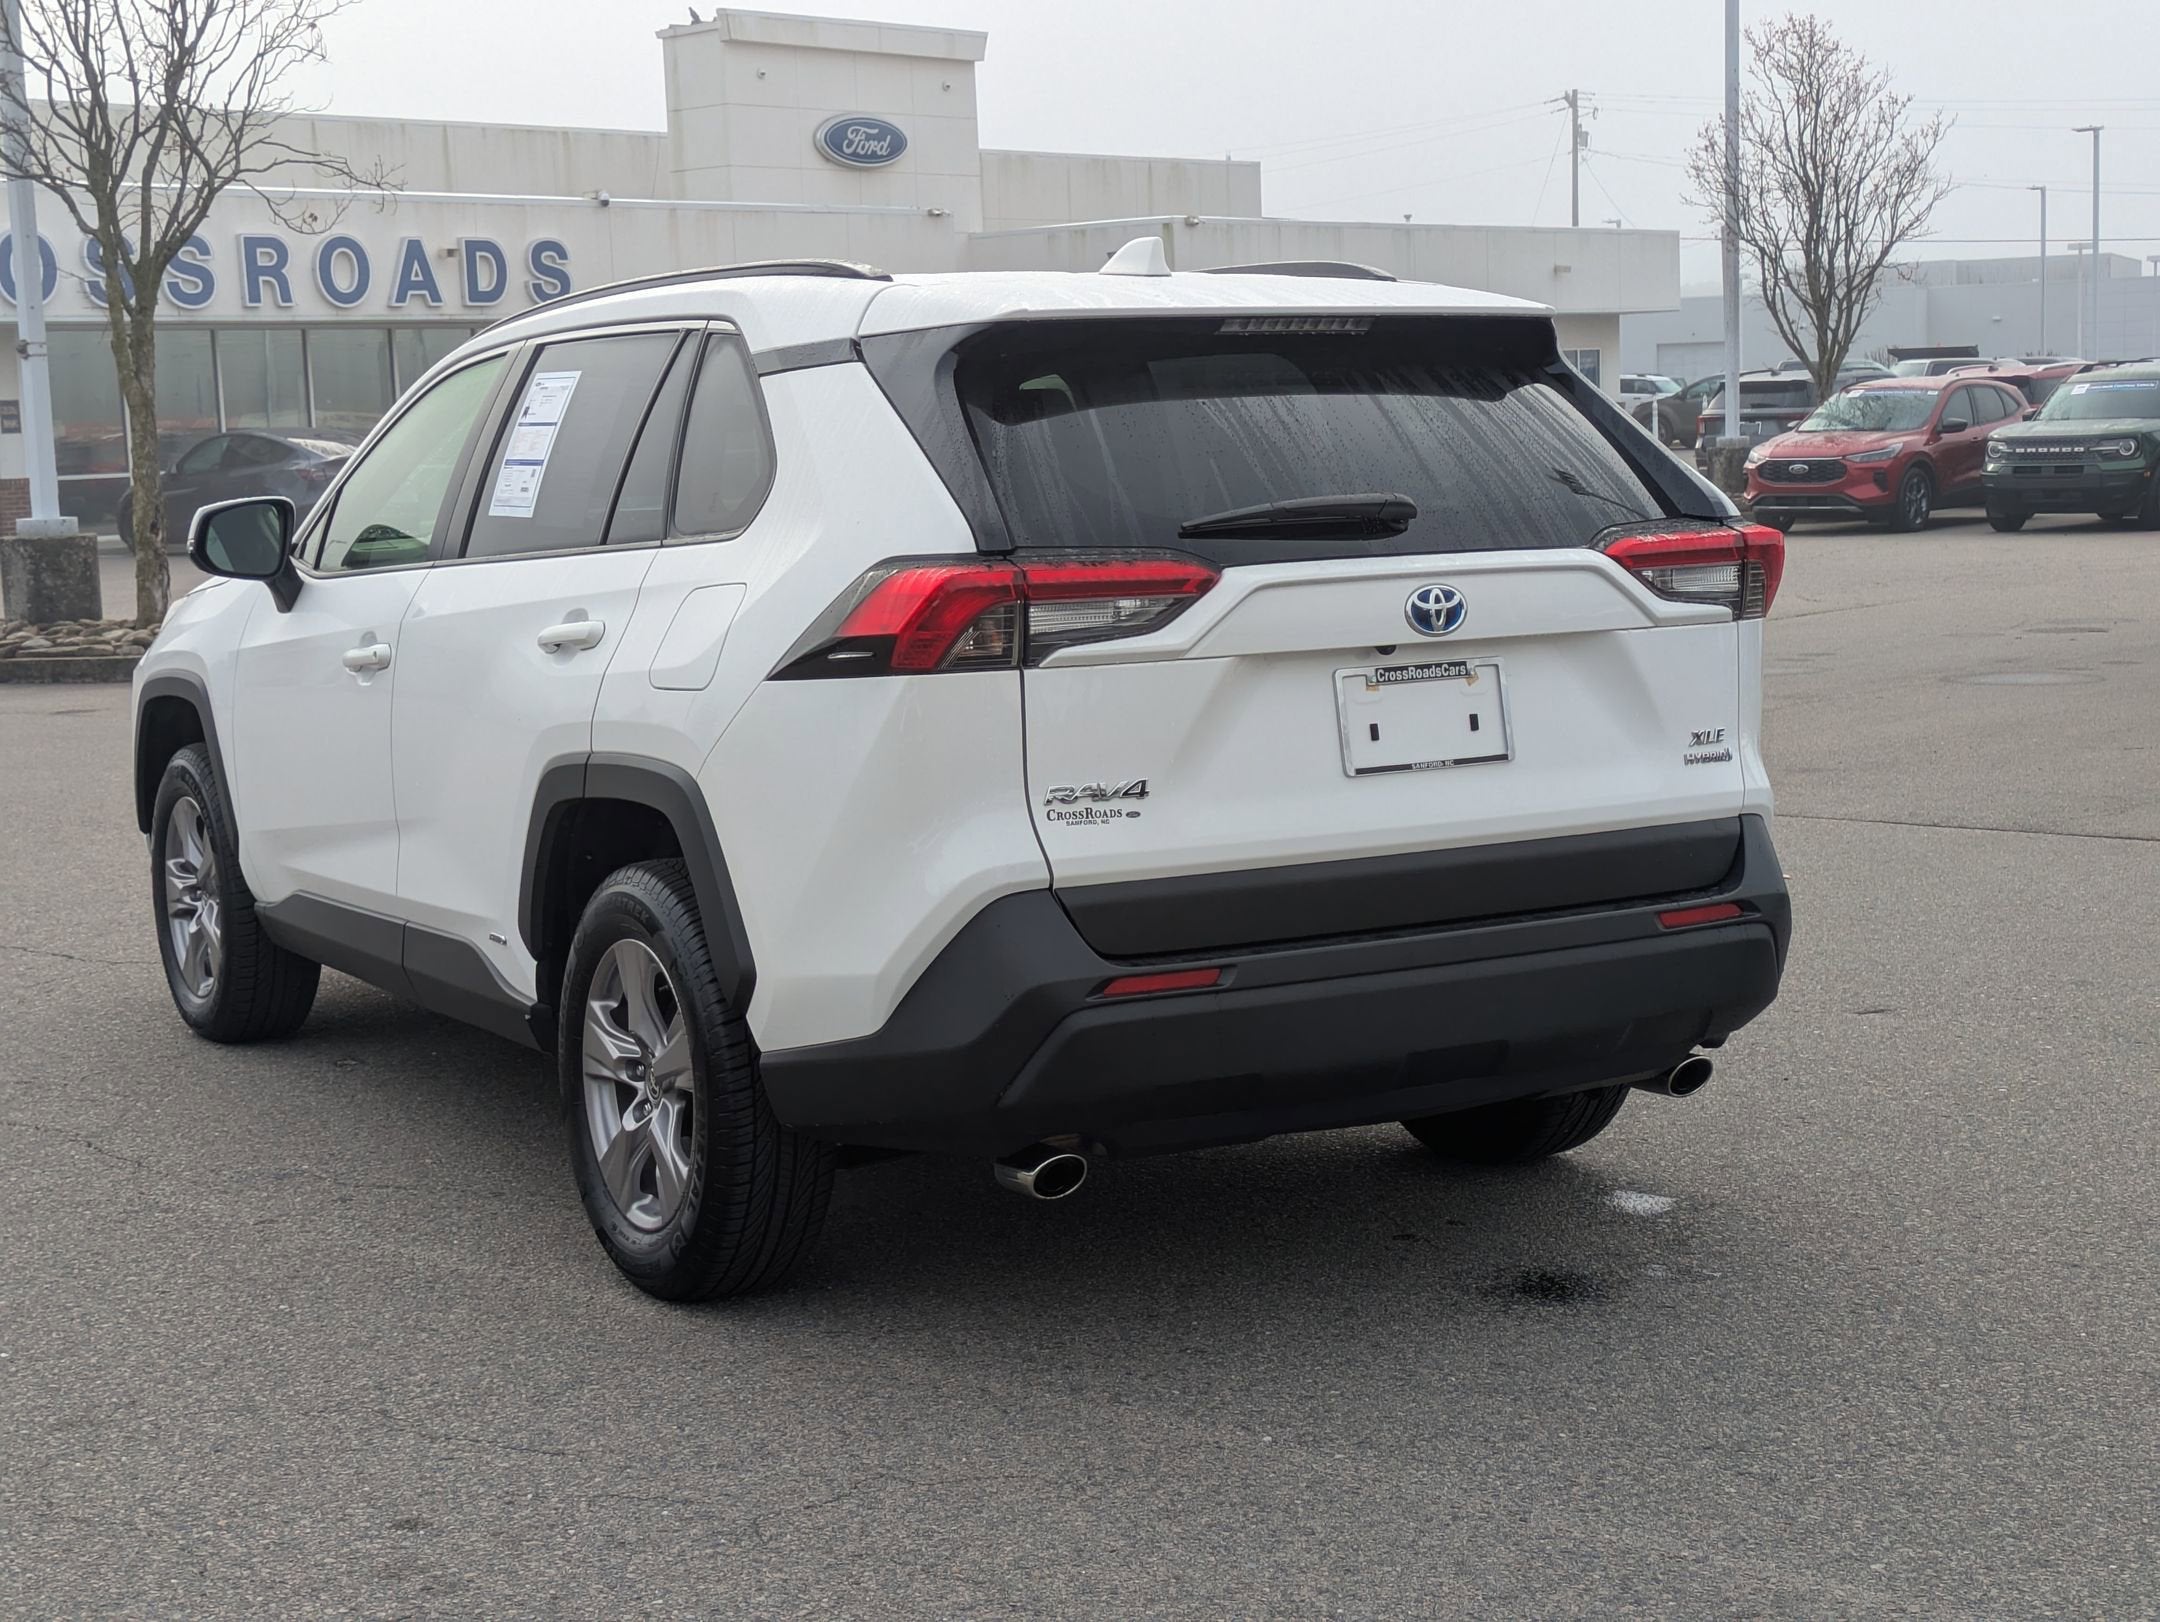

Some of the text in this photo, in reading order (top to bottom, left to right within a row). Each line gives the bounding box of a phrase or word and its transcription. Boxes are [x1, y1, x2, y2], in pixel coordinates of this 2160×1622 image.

[842, 126, 891, 156] Ford
[2015, 446, 2085, 454] BRONCO
[1377, 664, 1467, 682] CrossRoadsCars
[1688, 727, 1726, 748] XLE
[1044, 778, 1150, 806] RAV4
